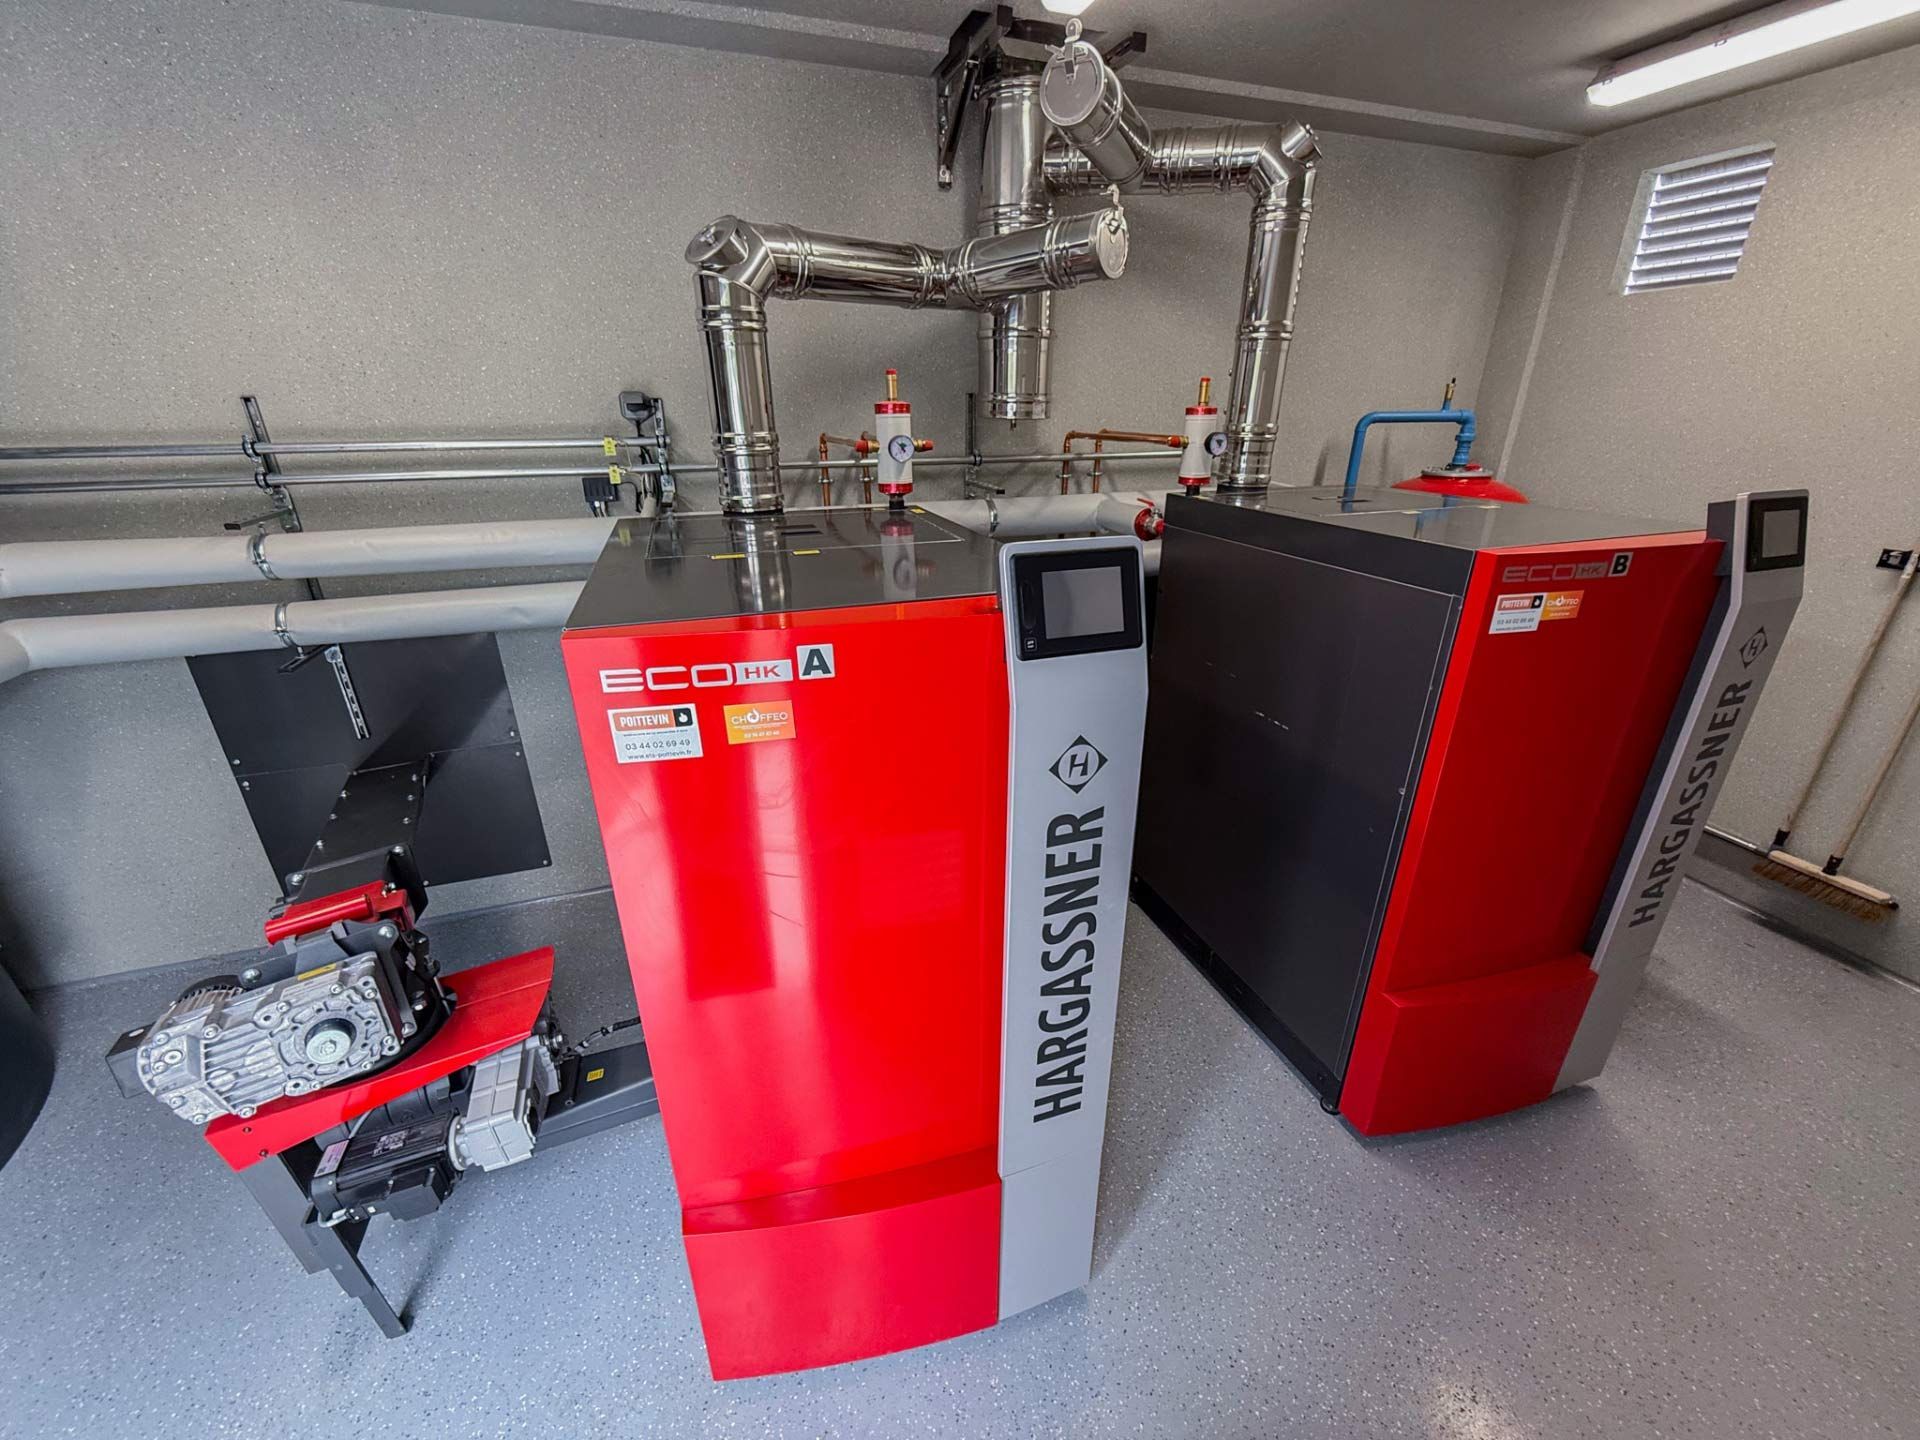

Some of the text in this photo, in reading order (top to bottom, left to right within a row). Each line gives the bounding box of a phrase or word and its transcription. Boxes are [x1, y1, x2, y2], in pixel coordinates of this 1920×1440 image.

[1502, 564, 1576, 583] ECO
[1611, 554, 1630, 575] B
[801, 648, 832, 676] A
[599, 662, 781, 694] ECO HK
[619, 713, 670, 728] POITTEVIN
[625, 743, 637, 751] 03
[652, 741, 664, 749] 02
[665, 740, 677, 748] 69
[679, 738, 691, 746] 49
[1628, 679, 1753, 928] HARGASSNER
[1032, 805, 1105, 1123] HARGASSNER
